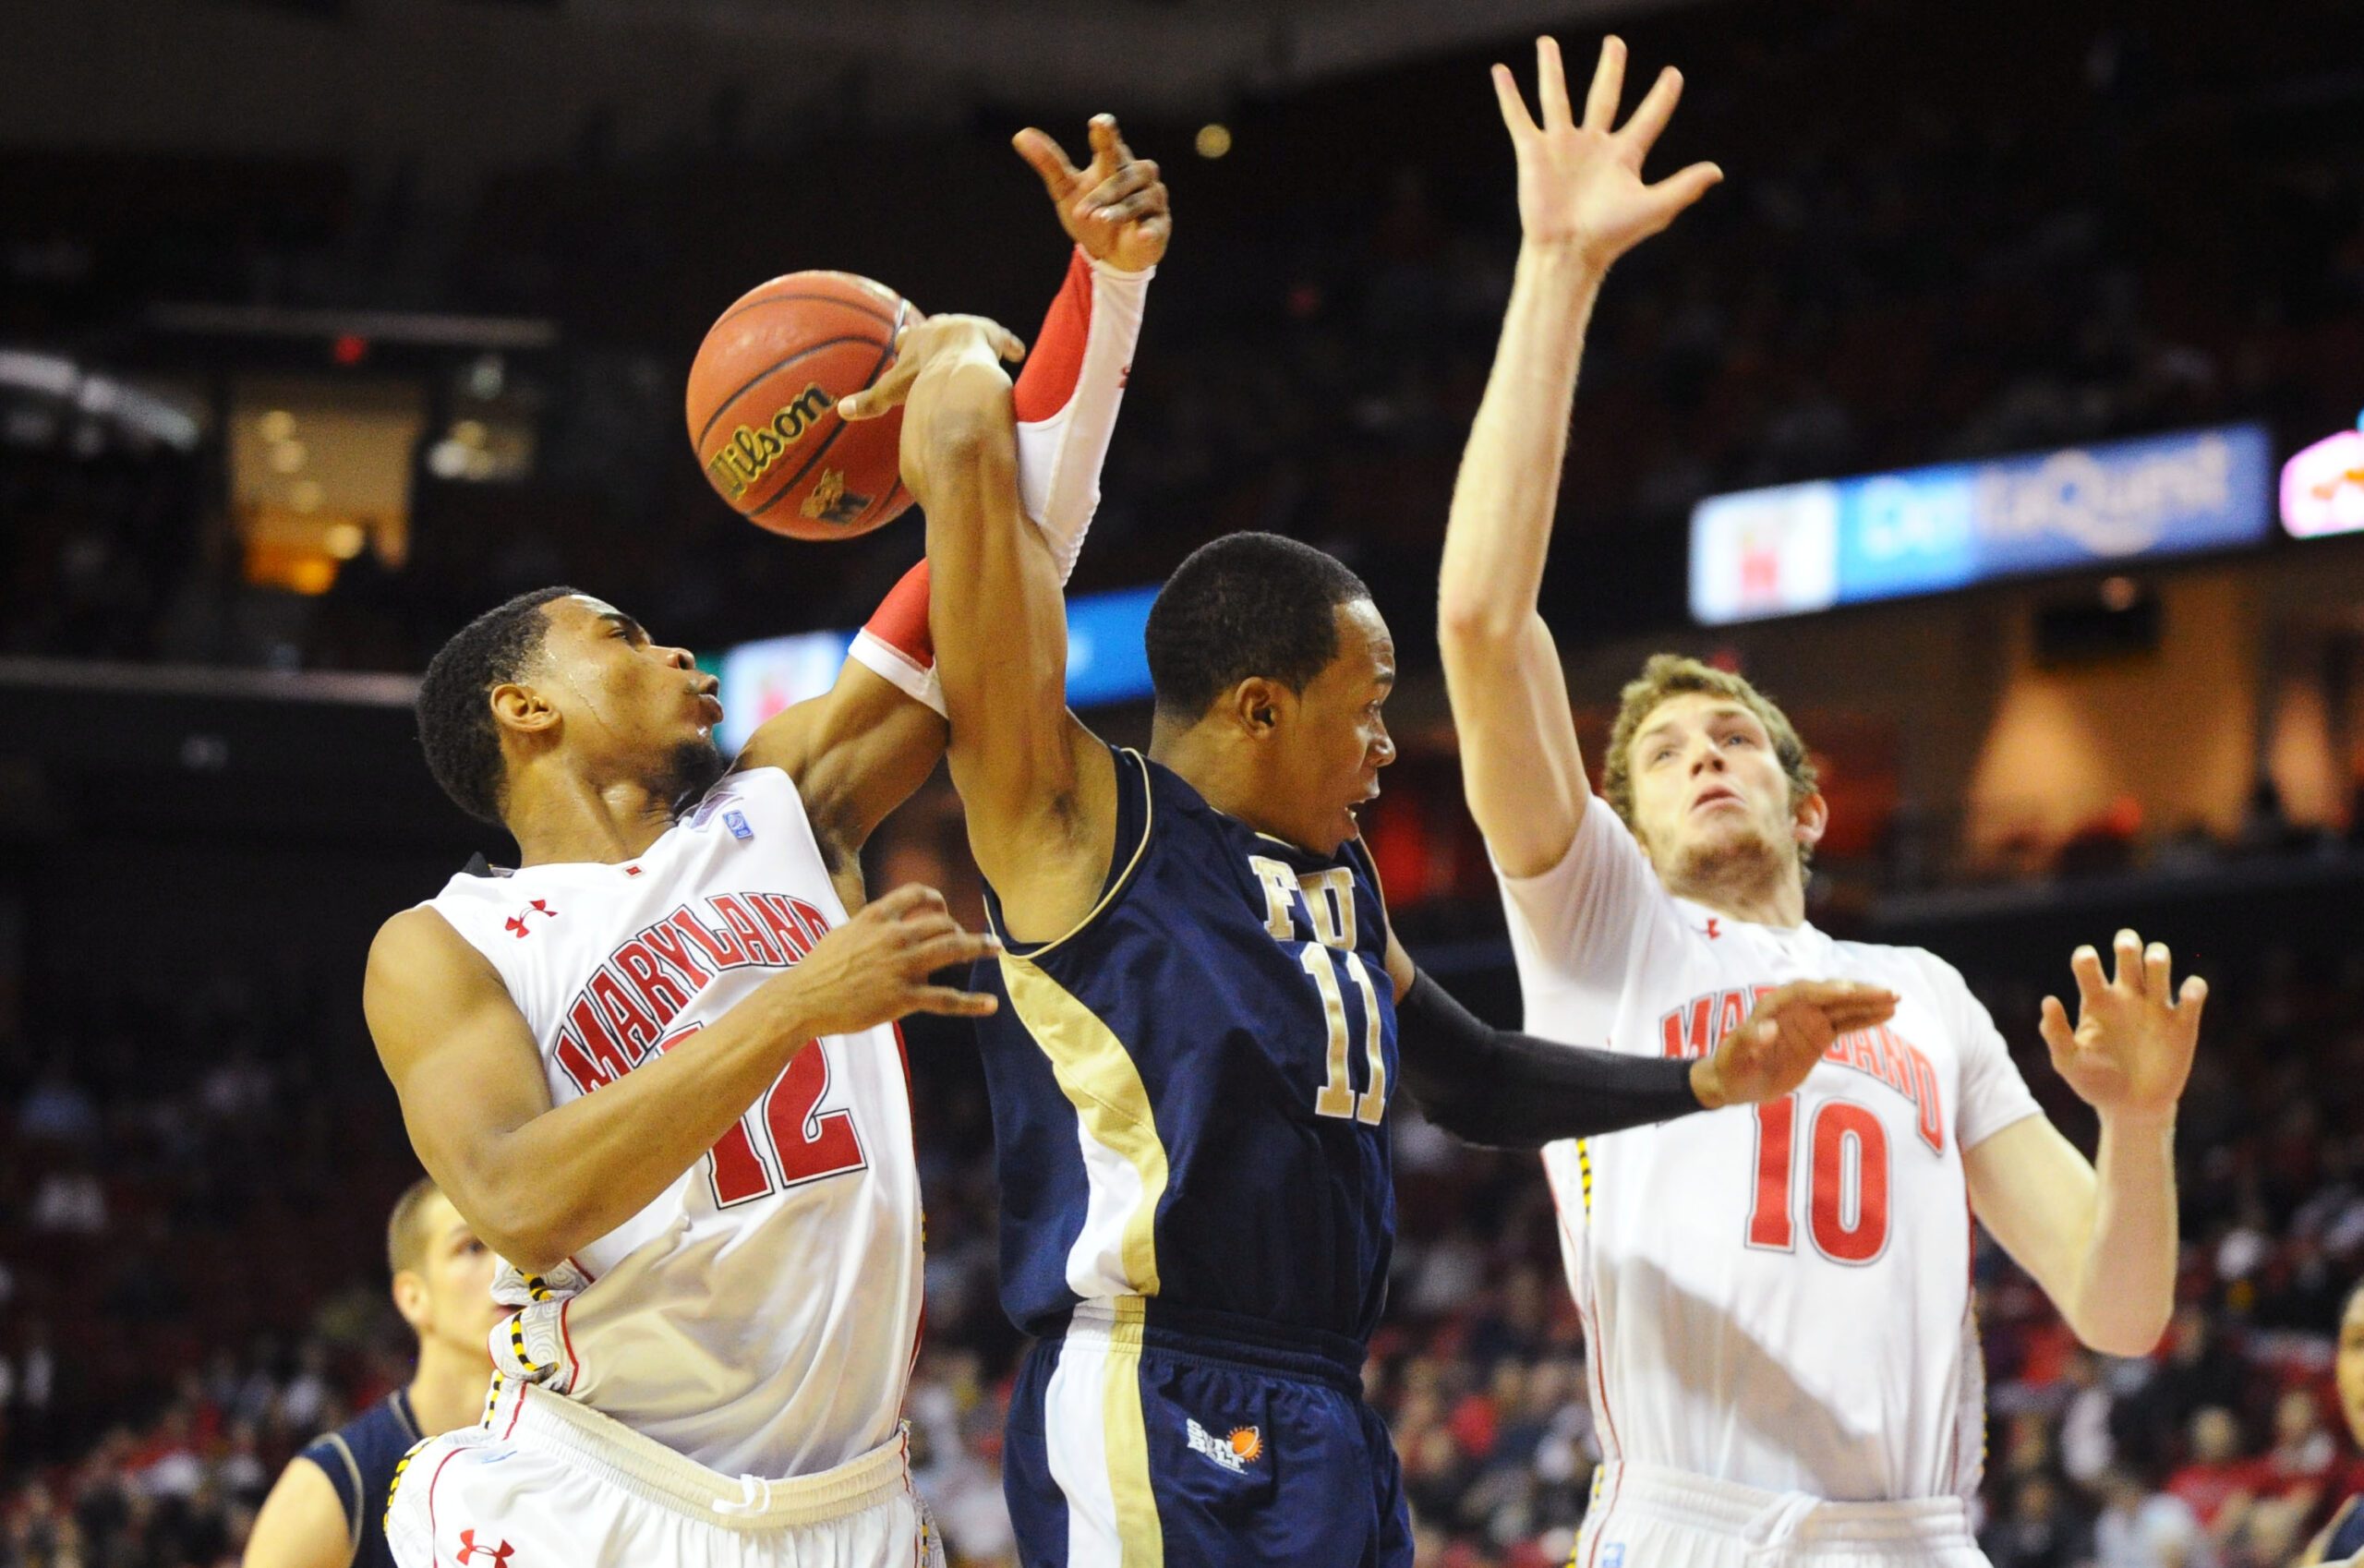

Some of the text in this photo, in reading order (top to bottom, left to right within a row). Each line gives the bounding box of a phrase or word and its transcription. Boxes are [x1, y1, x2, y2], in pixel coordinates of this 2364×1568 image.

[553, 891, 833, 1097] MARYLAND
[1298, 940, 1385, 1127] 11
[1659, 984, 1945, 1157] MALAND
[1744, 1092, 1892, 1268] 10
